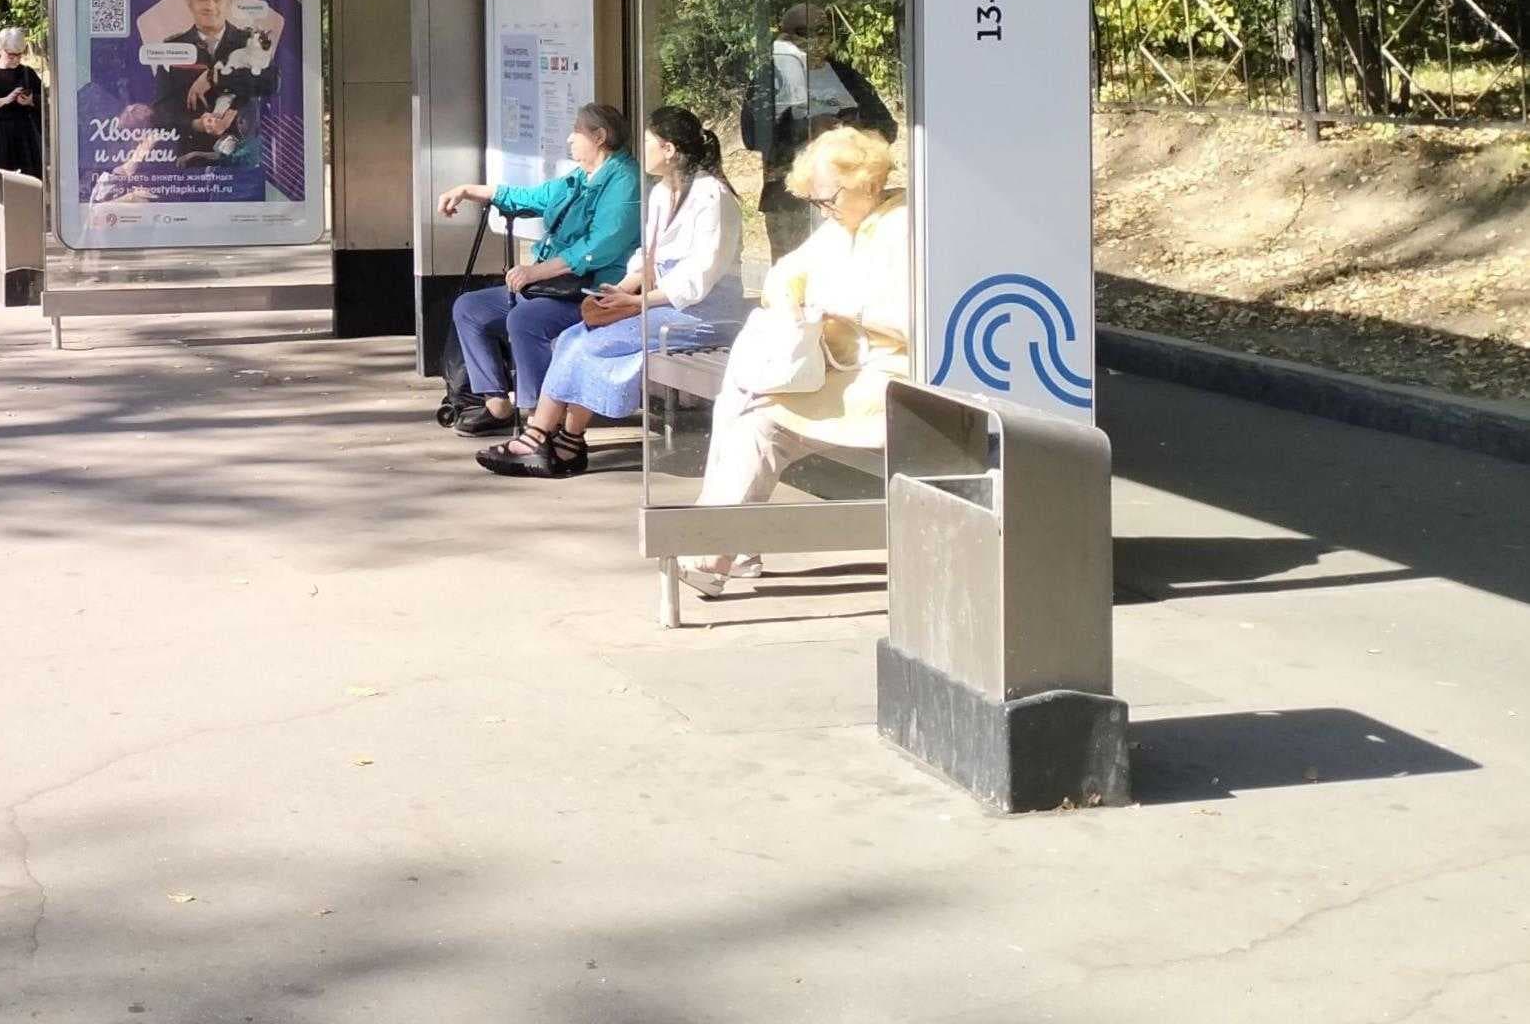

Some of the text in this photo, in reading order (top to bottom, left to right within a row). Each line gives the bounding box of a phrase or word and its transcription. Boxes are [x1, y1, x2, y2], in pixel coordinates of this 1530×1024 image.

[89, 116, 181, 142] Хвосты
[94, 147, 179, 163] и лапки
